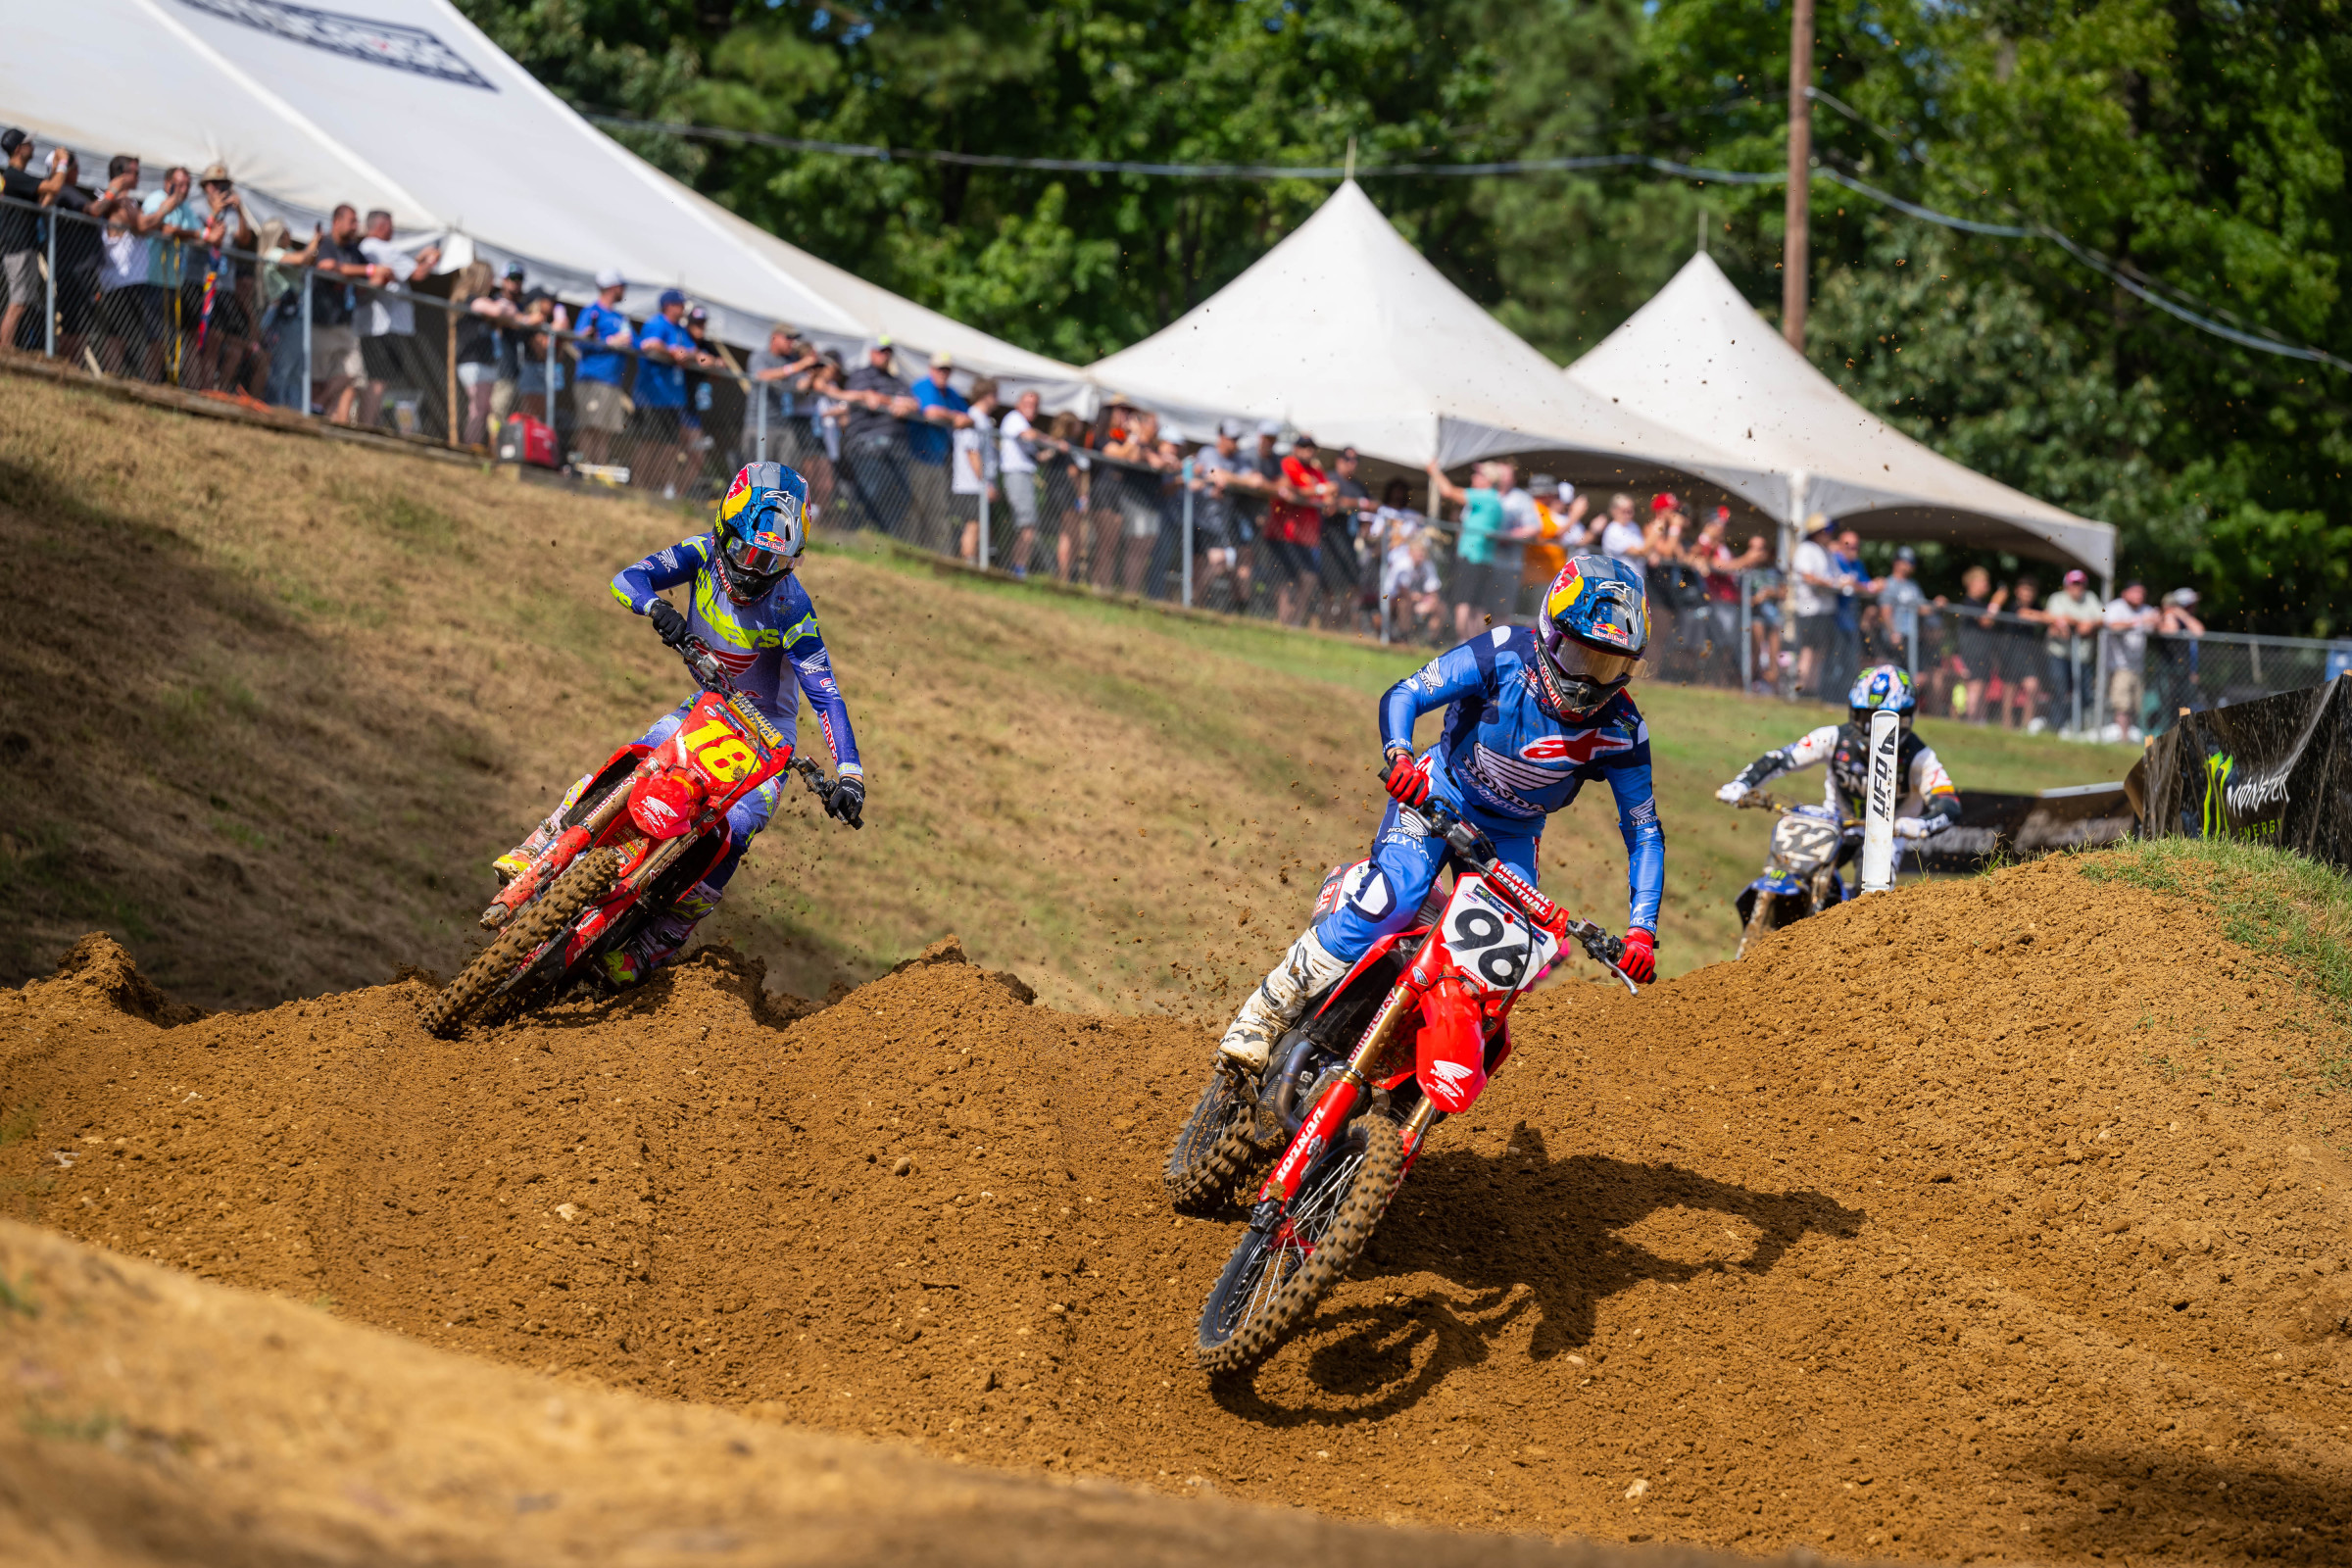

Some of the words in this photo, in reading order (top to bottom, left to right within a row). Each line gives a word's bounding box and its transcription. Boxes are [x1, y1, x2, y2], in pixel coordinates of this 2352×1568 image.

[754, 538, 770, 548] Red
[769, 542, 786, 552] Bull
[1592, 628, 1611, 640] Red
[1611, 631, 1629, 646] Bull
[1417, 668, 1434, 696] ONDA
[683, 719, 761, 783] 18
[1461, 753, 1546, 812] HONDA
[1873, 755, 1888, 818] UFO
[640, 800, 666, 829] HONDA
[1387, 827, 1424, 845] HONDA
[1775, 822, 1838, 858] 32
[1494, 871, 1548, 916] RENTHAL
[1497, 863, 1553, 907] RENTHAL
[1445, 907, 1533, 988] 96
[1459, 966, 1486, 988] HONDA
[1430, 1068, 1464, 1098] HONDA
[1277, 1106, 1325, 1184] DUNLOP
